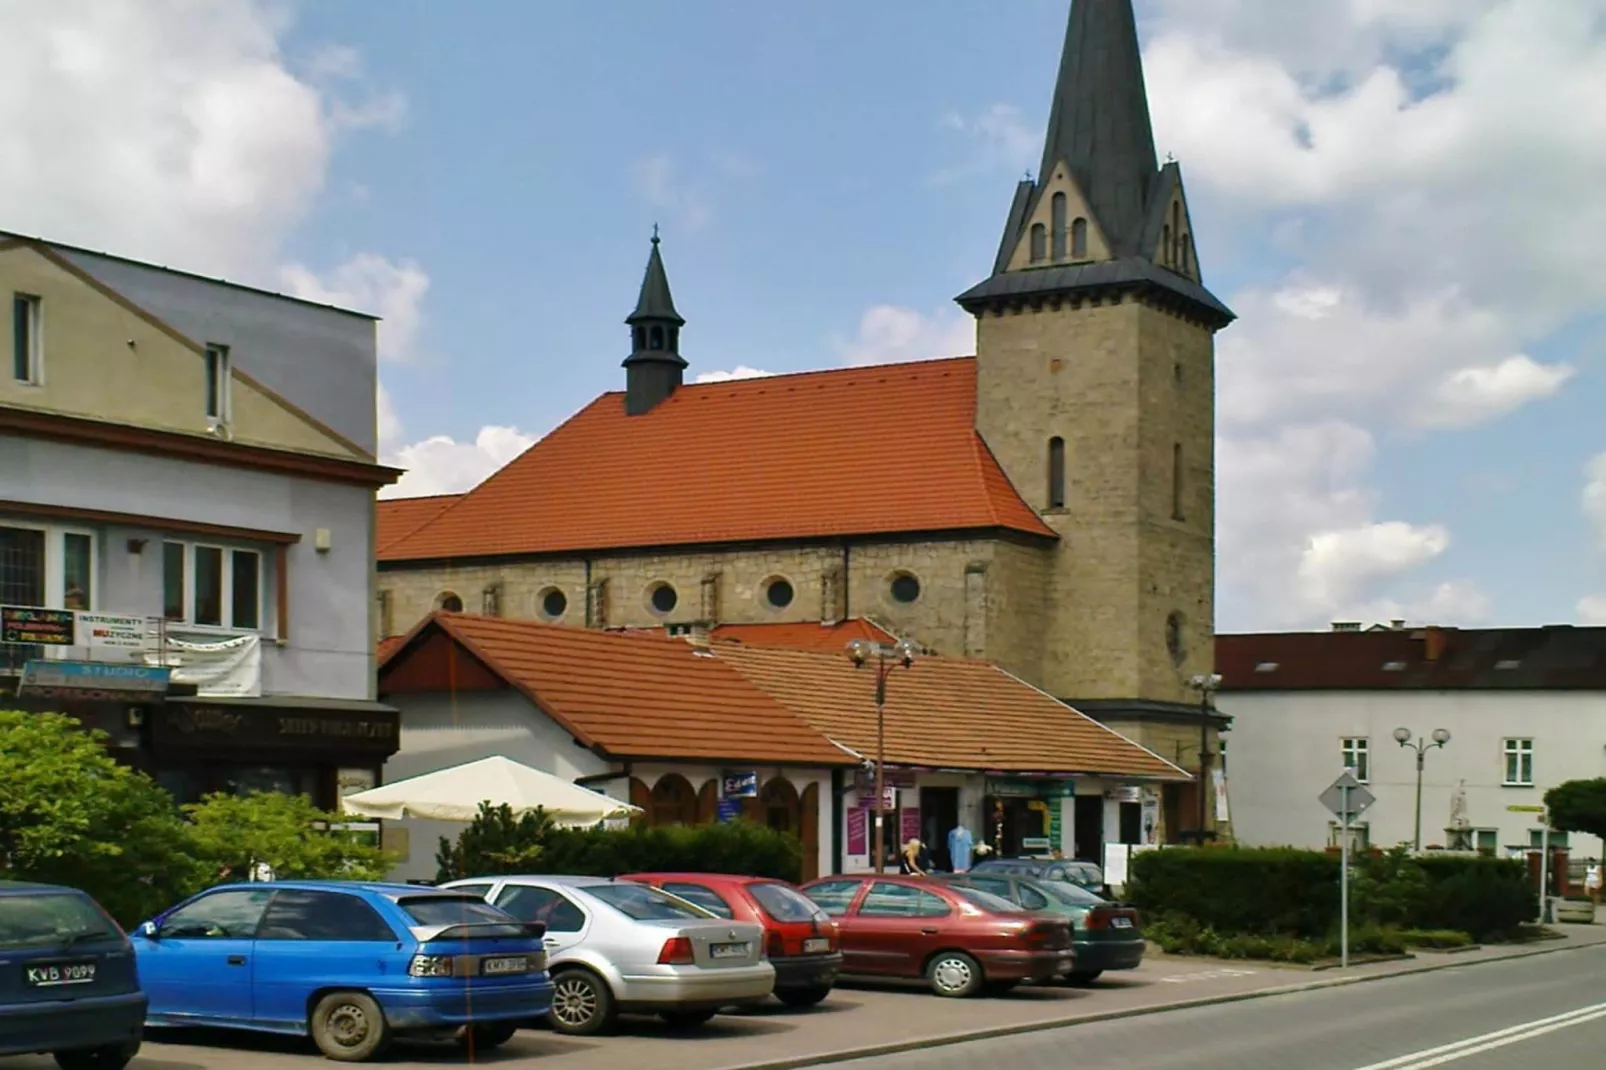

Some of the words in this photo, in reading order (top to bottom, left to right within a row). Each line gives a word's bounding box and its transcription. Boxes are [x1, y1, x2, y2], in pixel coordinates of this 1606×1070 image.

[79, 615, 142, 625] INSTRUMENTY
[93, 629, 143, 640] MUZYCZNE
[81, 665, 149, 677] STUDIO
[28, 966, 60, 982] KVB
